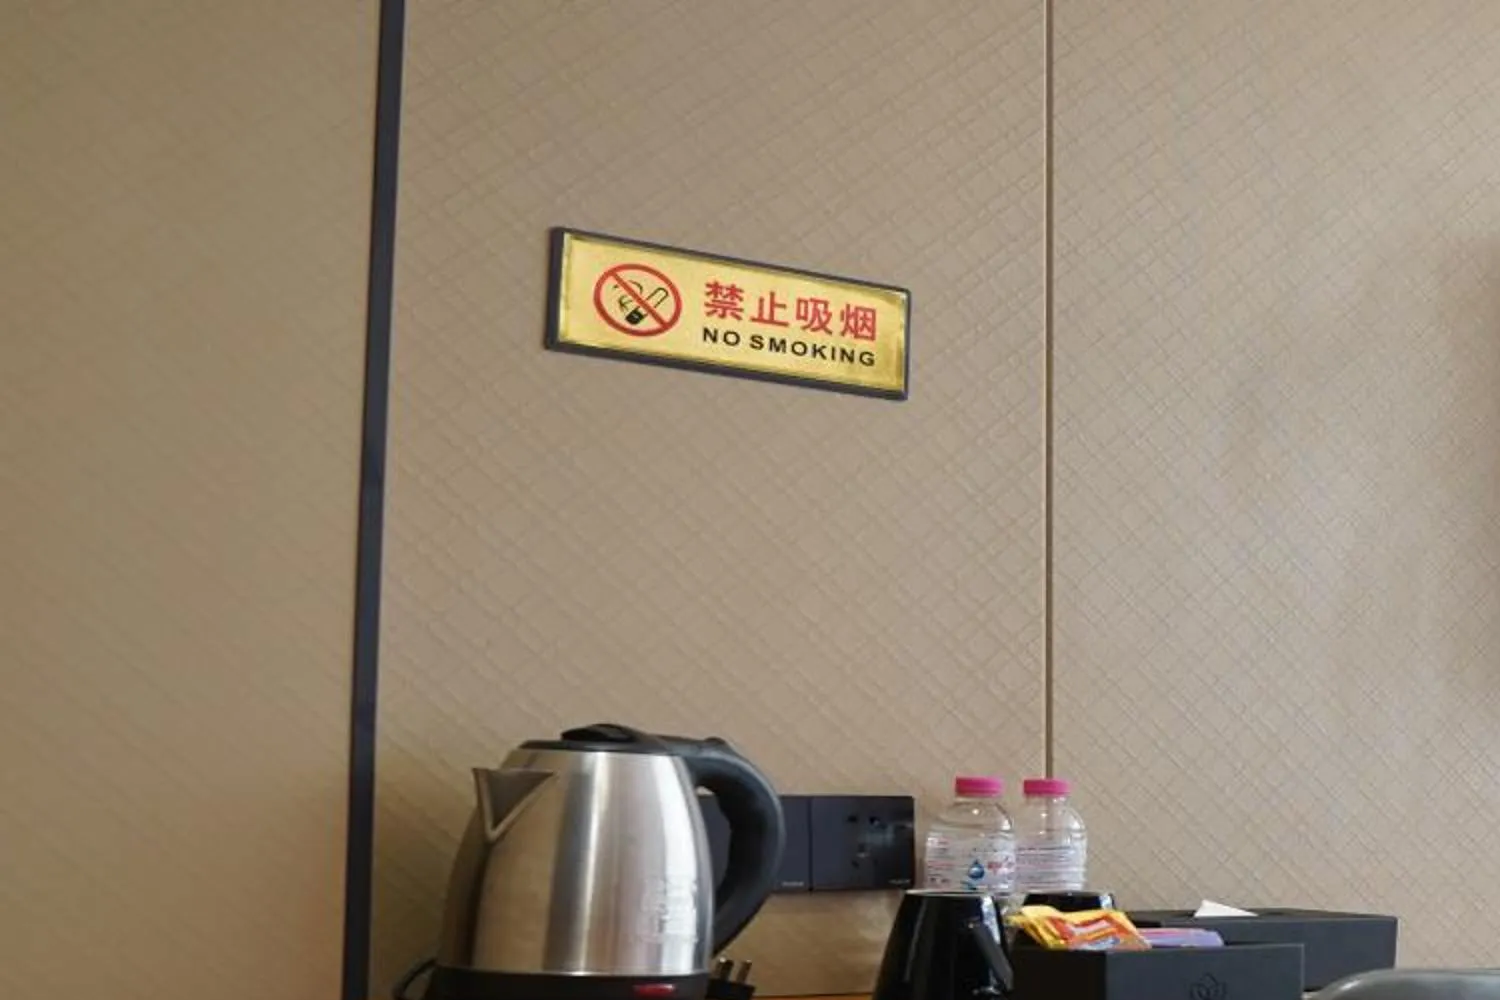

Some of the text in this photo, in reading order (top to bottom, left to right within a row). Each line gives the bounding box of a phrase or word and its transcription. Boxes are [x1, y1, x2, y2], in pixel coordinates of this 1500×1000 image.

[704, 280, 877, 342] 禁止吸烟
[702, 327, 876, 367] NO SMOKING
